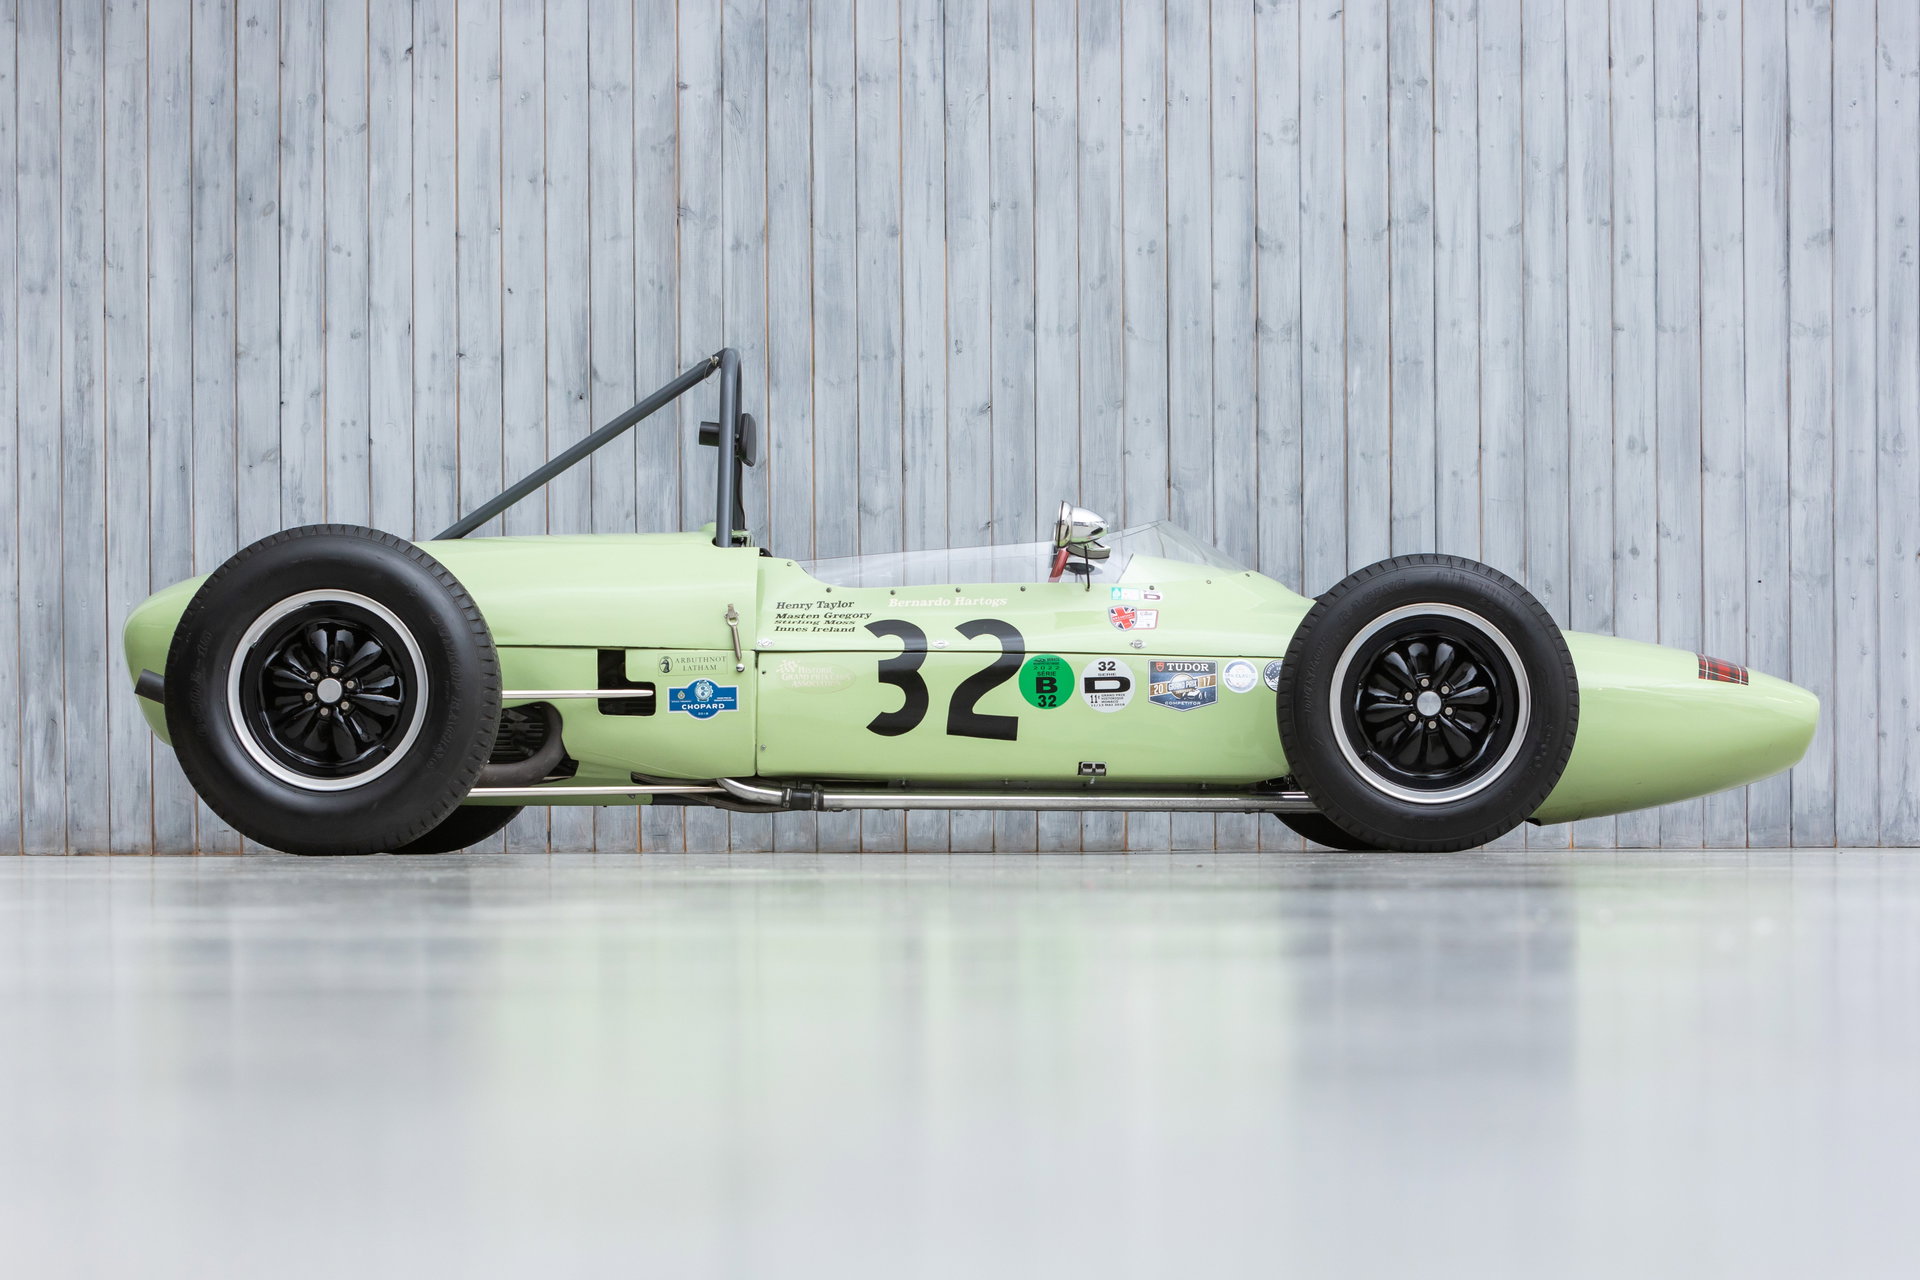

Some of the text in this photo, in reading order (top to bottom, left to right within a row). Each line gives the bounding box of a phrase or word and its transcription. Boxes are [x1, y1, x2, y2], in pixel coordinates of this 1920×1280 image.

[776, 600, 855, 611] Henry Taylor
[888, 596, 1008, 607] Bernardo Hartogs
[823, 612, 872, 620] Gregory
[675, 656, 727, 664] ARBUTHNOT
[1098, 661, 1116, 671] 32
[1167, 663, 1210, 671] TUDOR
[863, 618, 1026, 742] 32
[1035, 676, 1058, 694] B
[1084, 676, 1131, 694] D
[1154, 684, 1164, 695] 20
[1202, 676, 1211, 686] 17
[1037, 694, 1057, 708] 32
